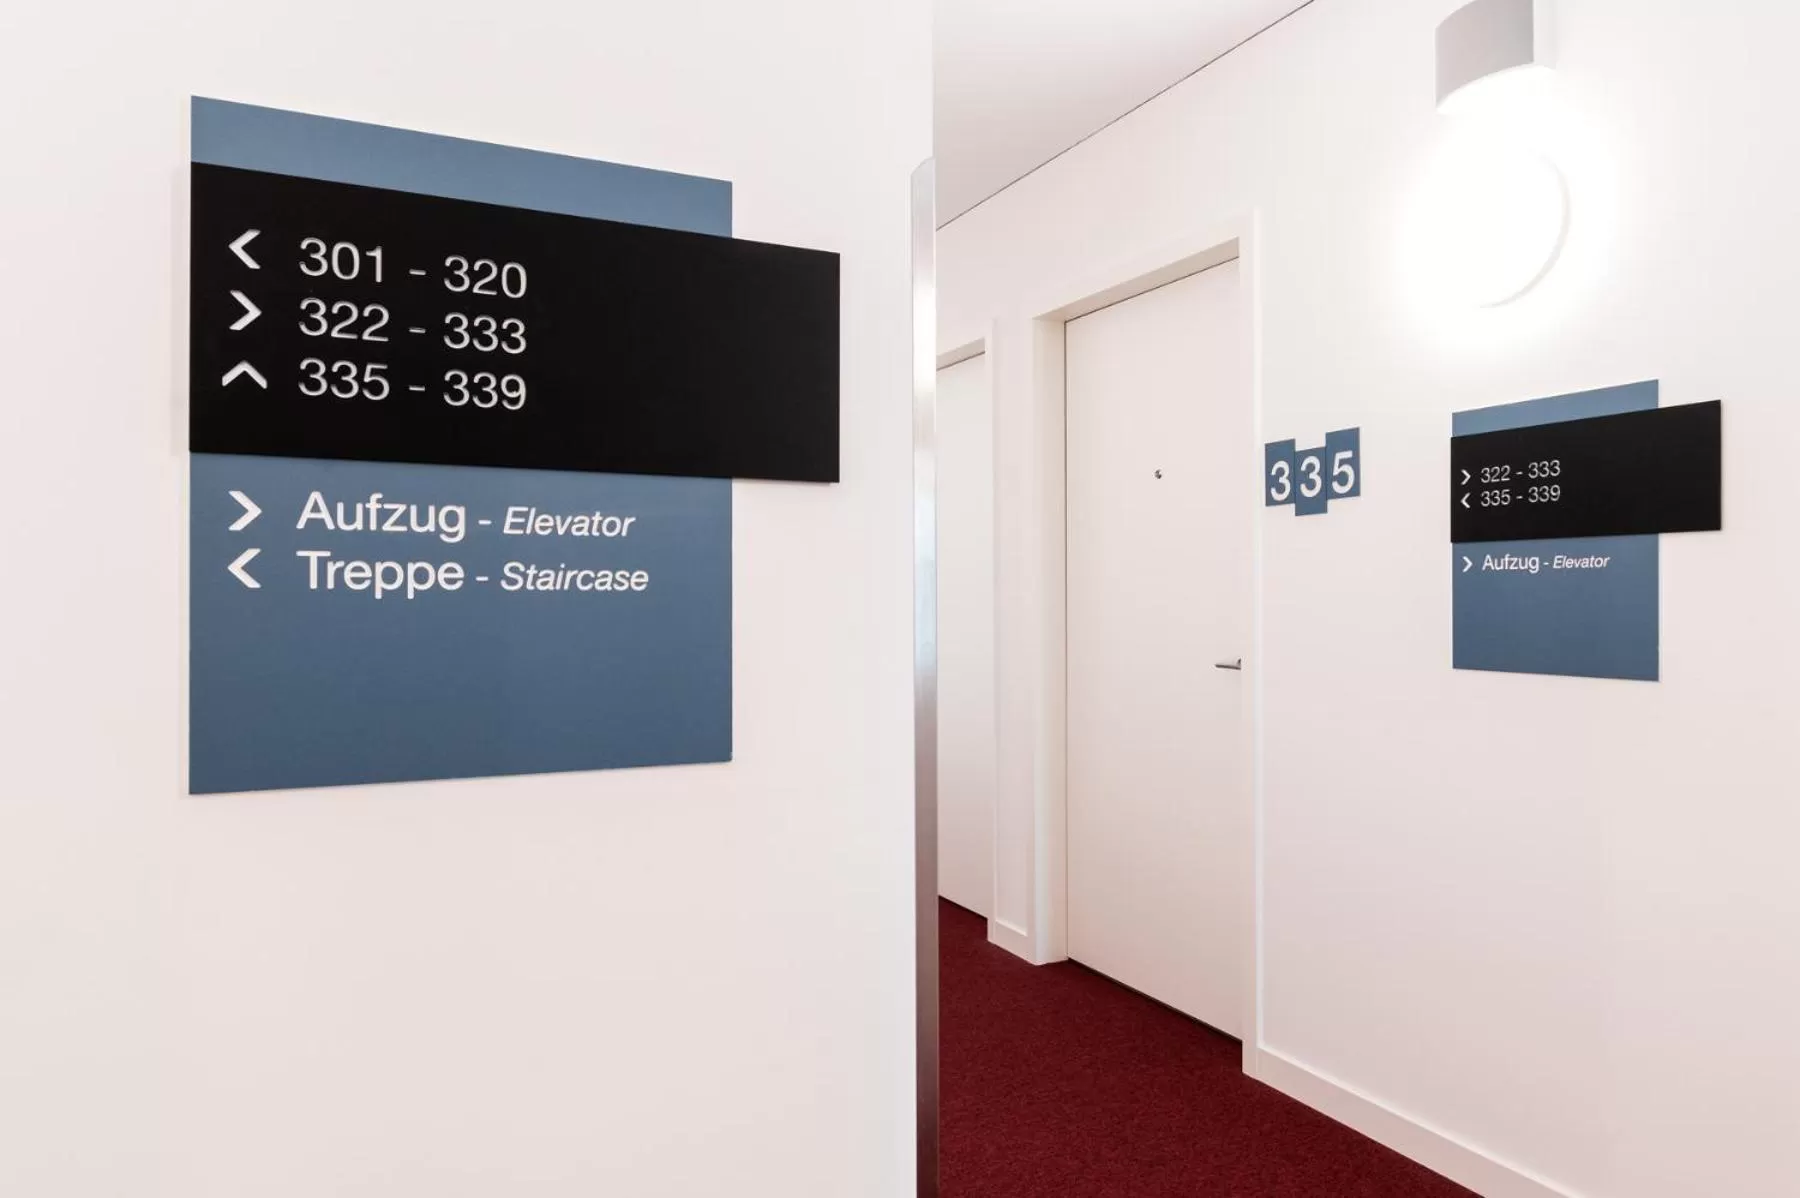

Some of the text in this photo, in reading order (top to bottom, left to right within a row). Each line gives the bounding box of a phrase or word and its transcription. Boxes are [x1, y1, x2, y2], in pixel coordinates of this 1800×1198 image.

[299, 237, 383, 283] 301
[444, 256, 527, 299] 320
[299, 298, 390, 342] 322
[443, 312, 527, 355] 333
[298, 358, 390, 401] 335
[443, 370, 527, 411] 339
[1270, 450, 1355, 501] 335
[1480, 464, 1511, 484] 322
[1528, 459, 1561, 479] 333
[1480, 488, 1511, 507] 335
[1528, 484, 1561, 503] 339
[296, 491, 466, 544] Aufzug
[503, 506, 636, 537] Elevator
[295, 550, 465, 600] Treppe
[500, 561, 649, 592] Staircase
[1481, 553, 1540, 574] Aufzug
[1552, 554, 1611, 569] Elevator
